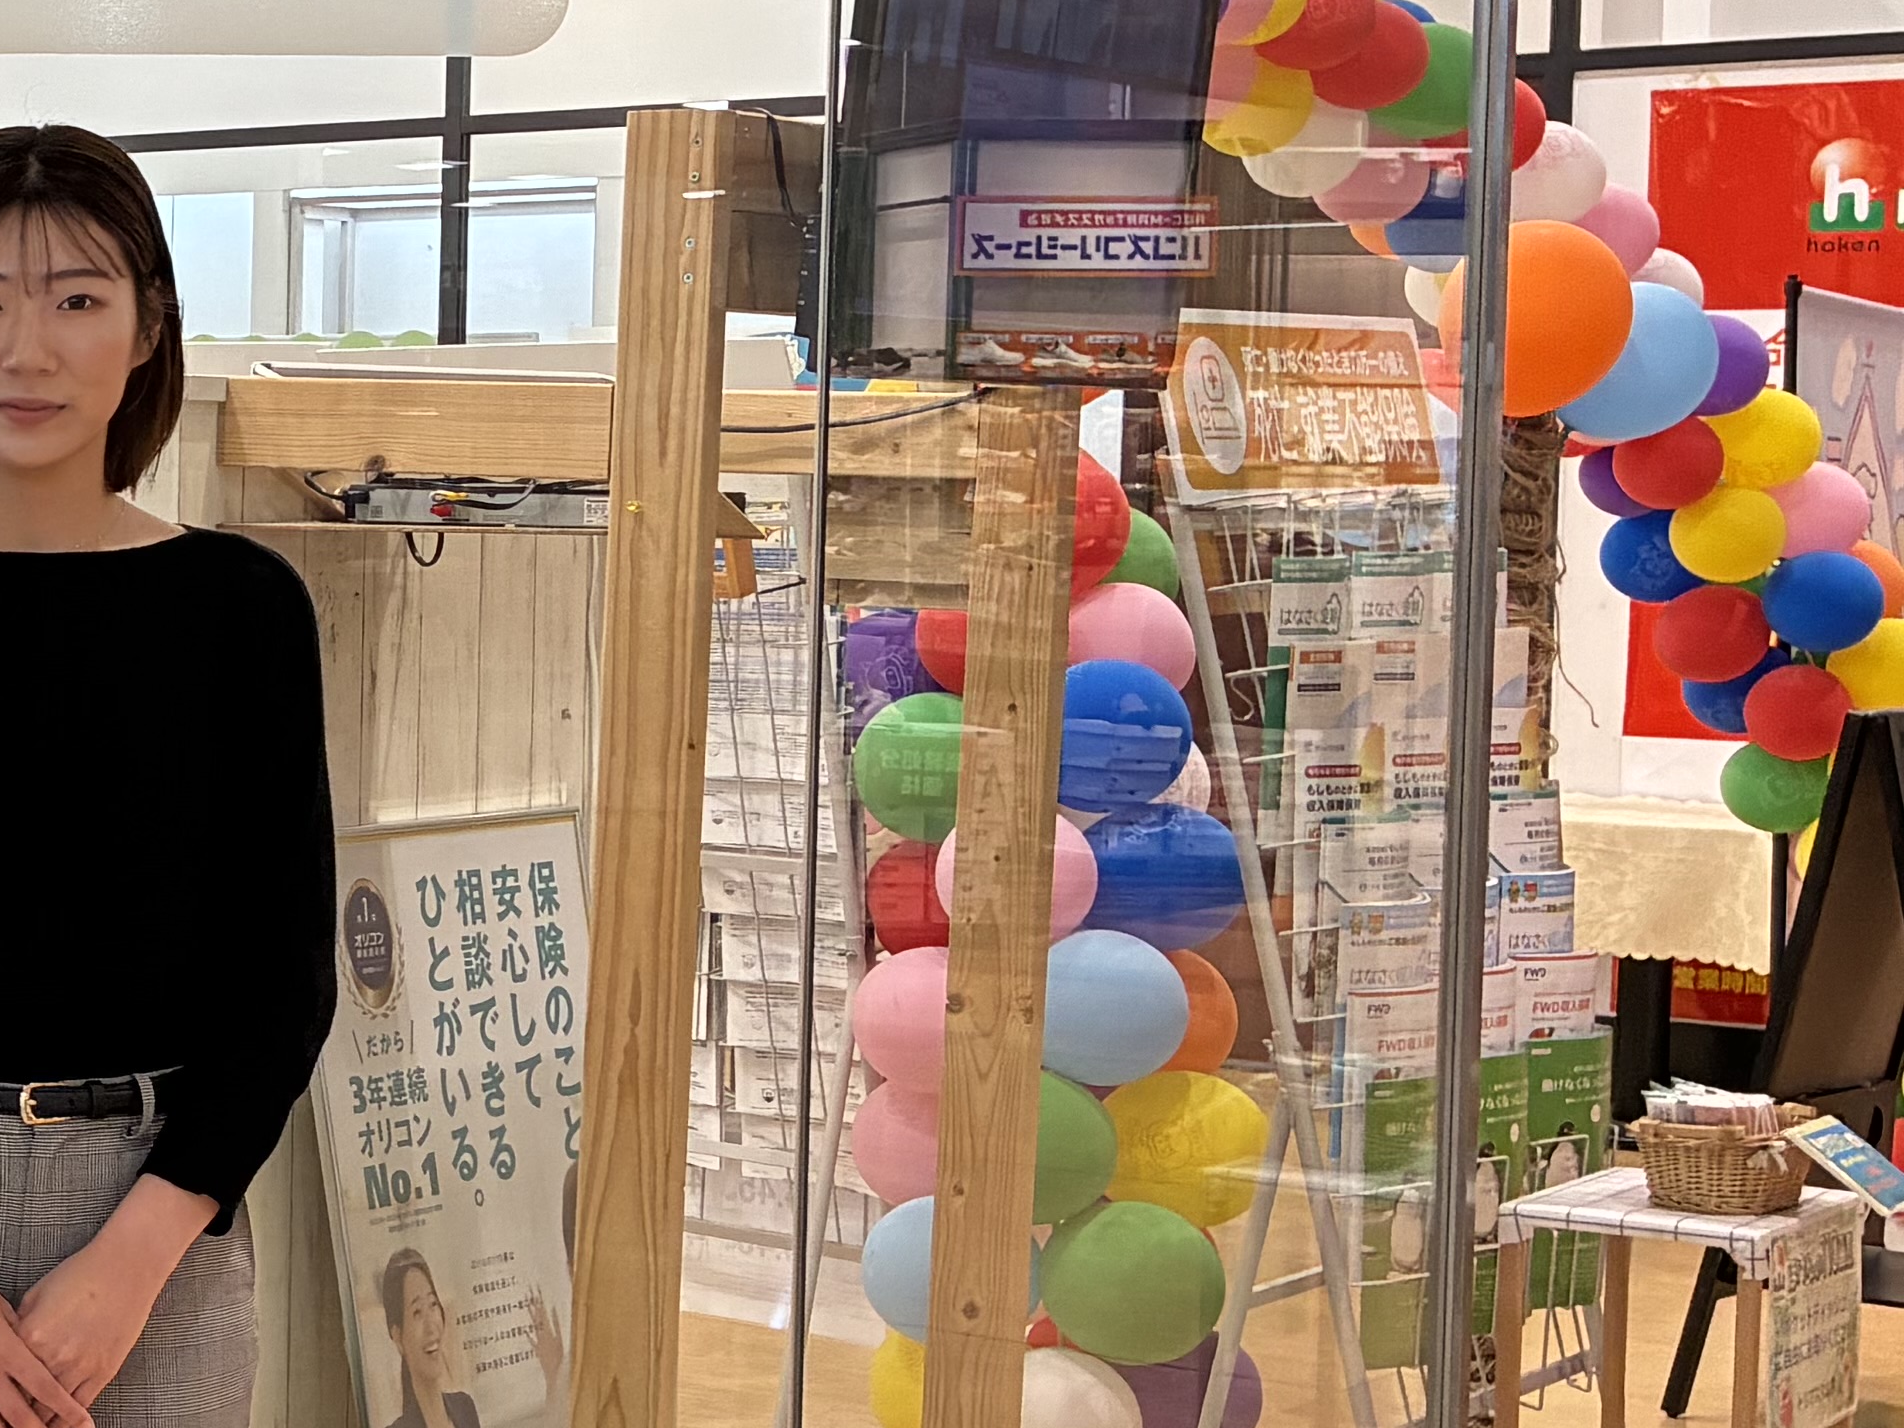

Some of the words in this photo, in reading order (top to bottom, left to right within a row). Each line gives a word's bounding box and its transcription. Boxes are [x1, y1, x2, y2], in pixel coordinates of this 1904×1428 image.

[1805, 237, 1881, 254] hoken
[490, 863, 543, 1109] 安心して
[453, 868, 517, 1181] 相談できる
[357, 1113, 432, 1159] オリコン
[363, 1151, 441, 1211] No.1
